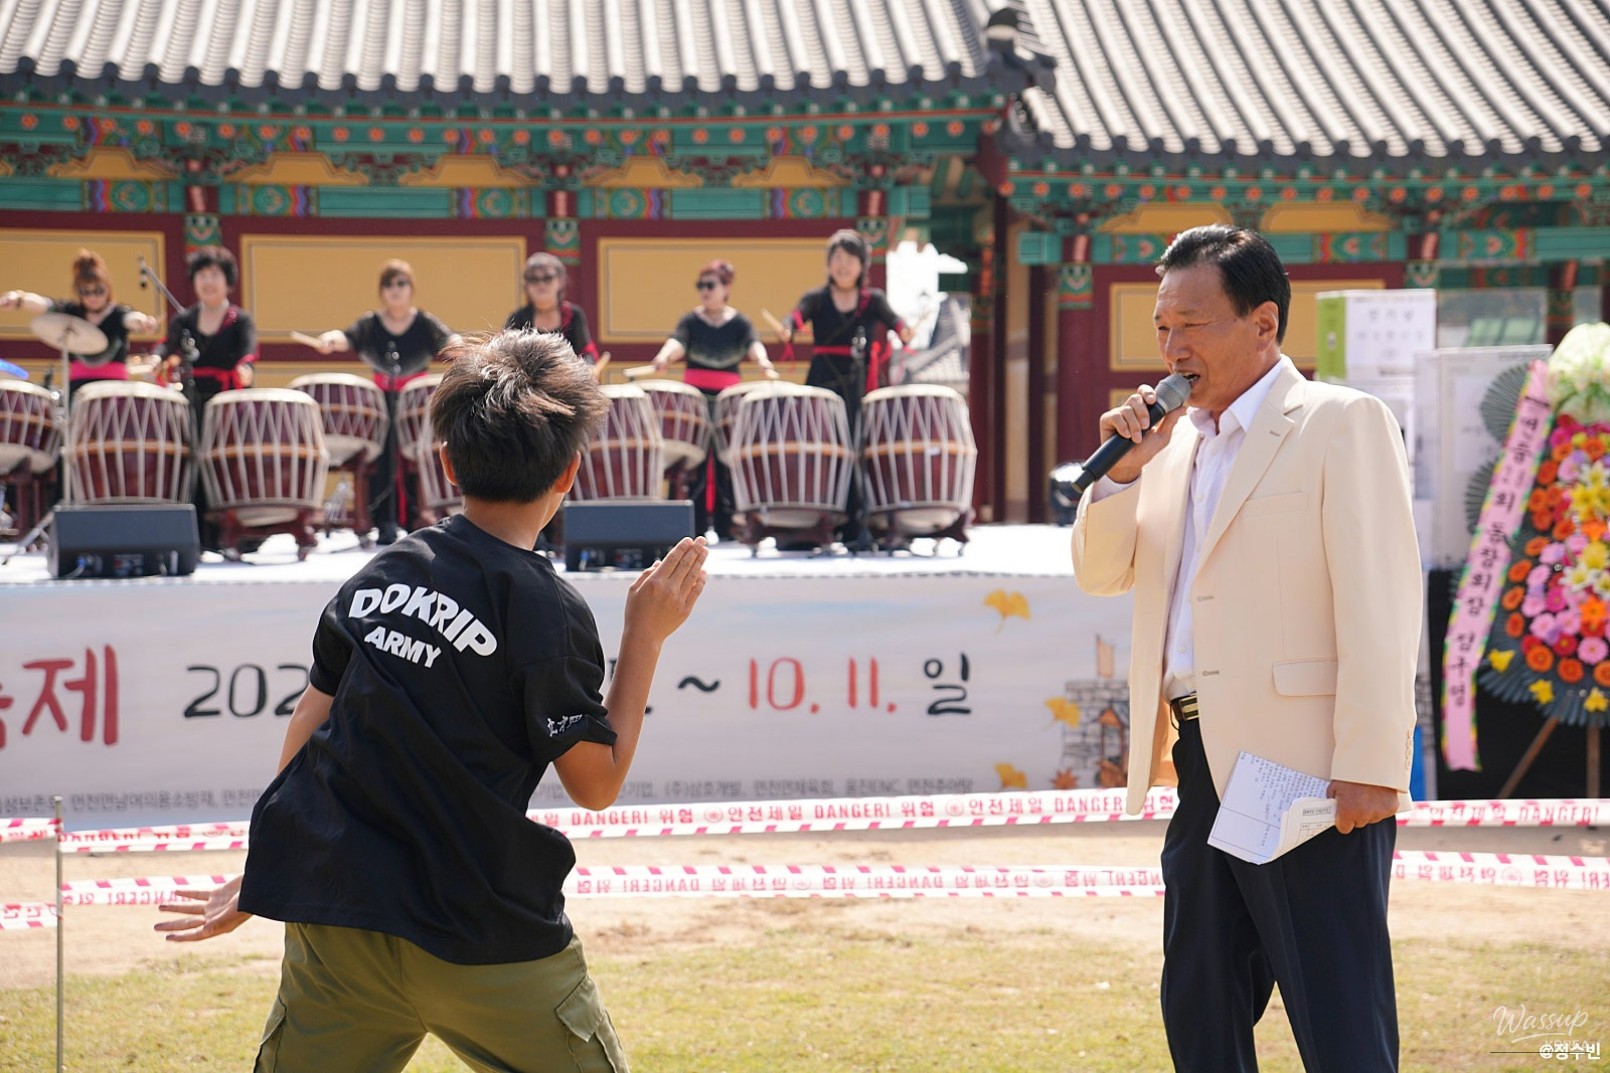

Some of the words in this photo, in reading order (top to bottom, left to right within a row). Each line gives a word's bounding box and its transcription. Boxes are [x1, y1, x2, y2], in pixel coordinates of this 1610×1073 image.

[348, 583, 498, 657] DOKRIP
[364, 626, 442, 668] ARMY
[0, 643, 119, 747] 제
[184, 663, 310, 719] 202
[748, 656, 820, 714] 10.
[923, 652, 972, 715] 일
[571, 810, 649, 827] DANGER!
[659, 808, 693, 825] 위험
[728, 805, 803, 823] 안전제일
[814, 803, 891, 820] DANGER!
[902, 801, 935, 818] 위험
[969, 798, 1043, 816] 안전제일
[1054, 796, 1123, 813] DANGER
